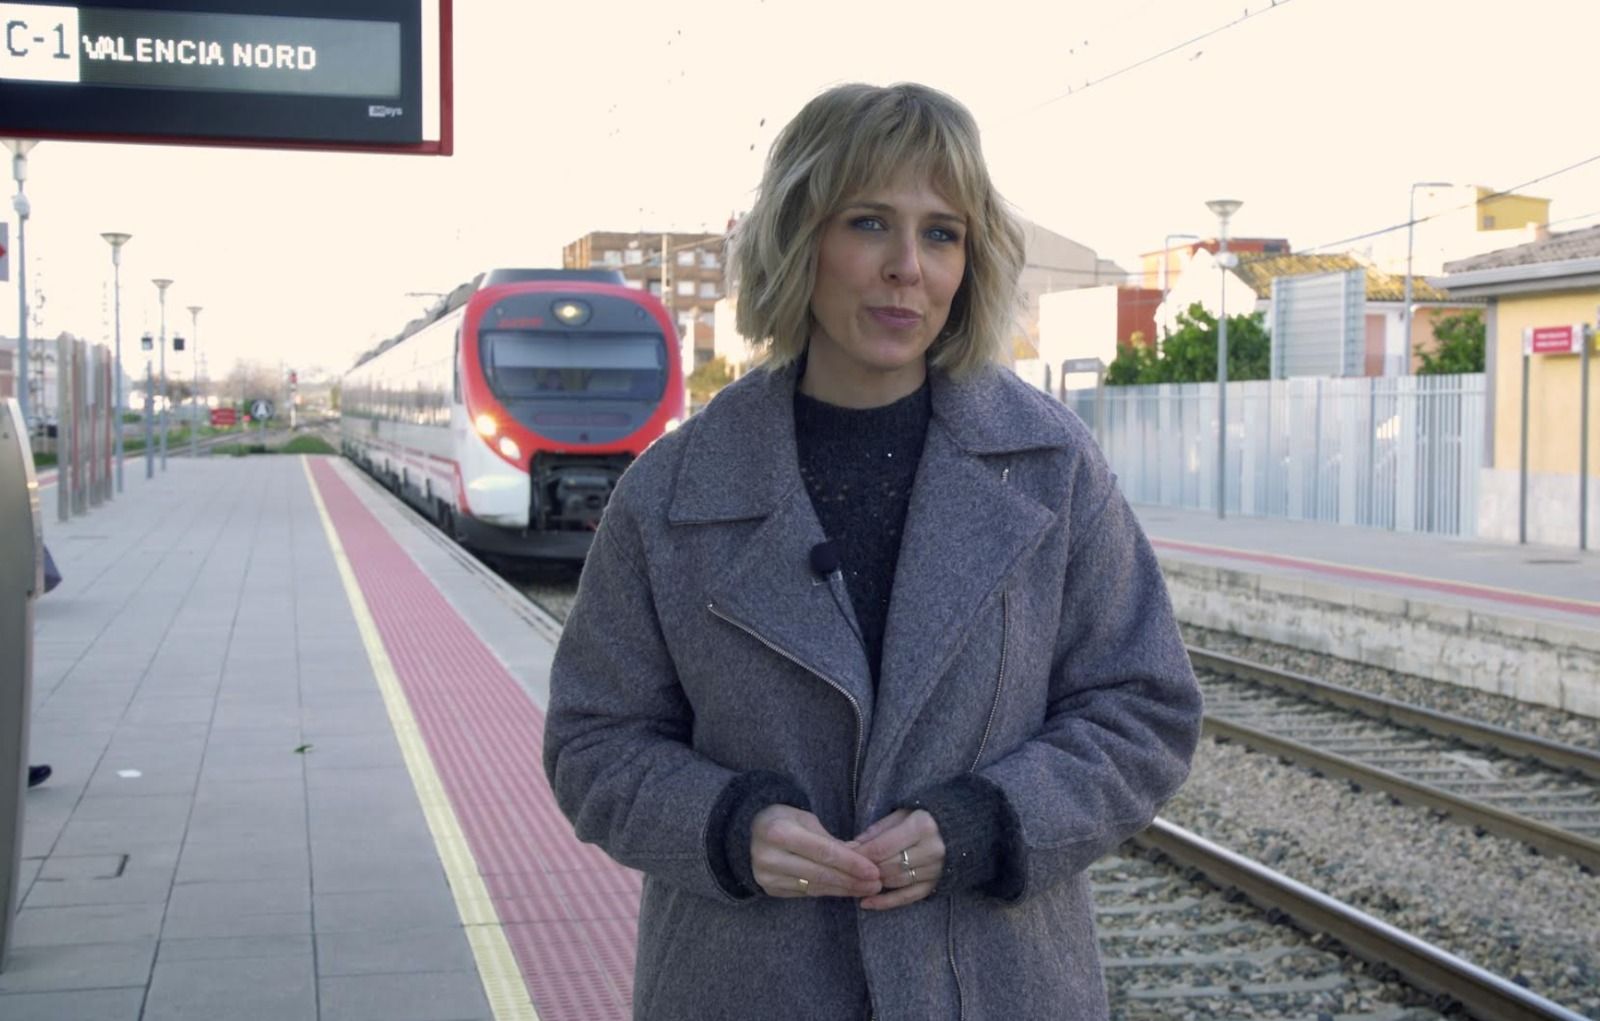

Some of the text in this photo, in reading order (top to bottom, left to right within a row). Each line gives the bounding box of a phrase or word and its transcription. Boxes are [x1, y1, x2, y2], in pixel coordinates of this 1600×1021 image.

[6, 20, 317, 71] C-1 VALENCIA NORD
